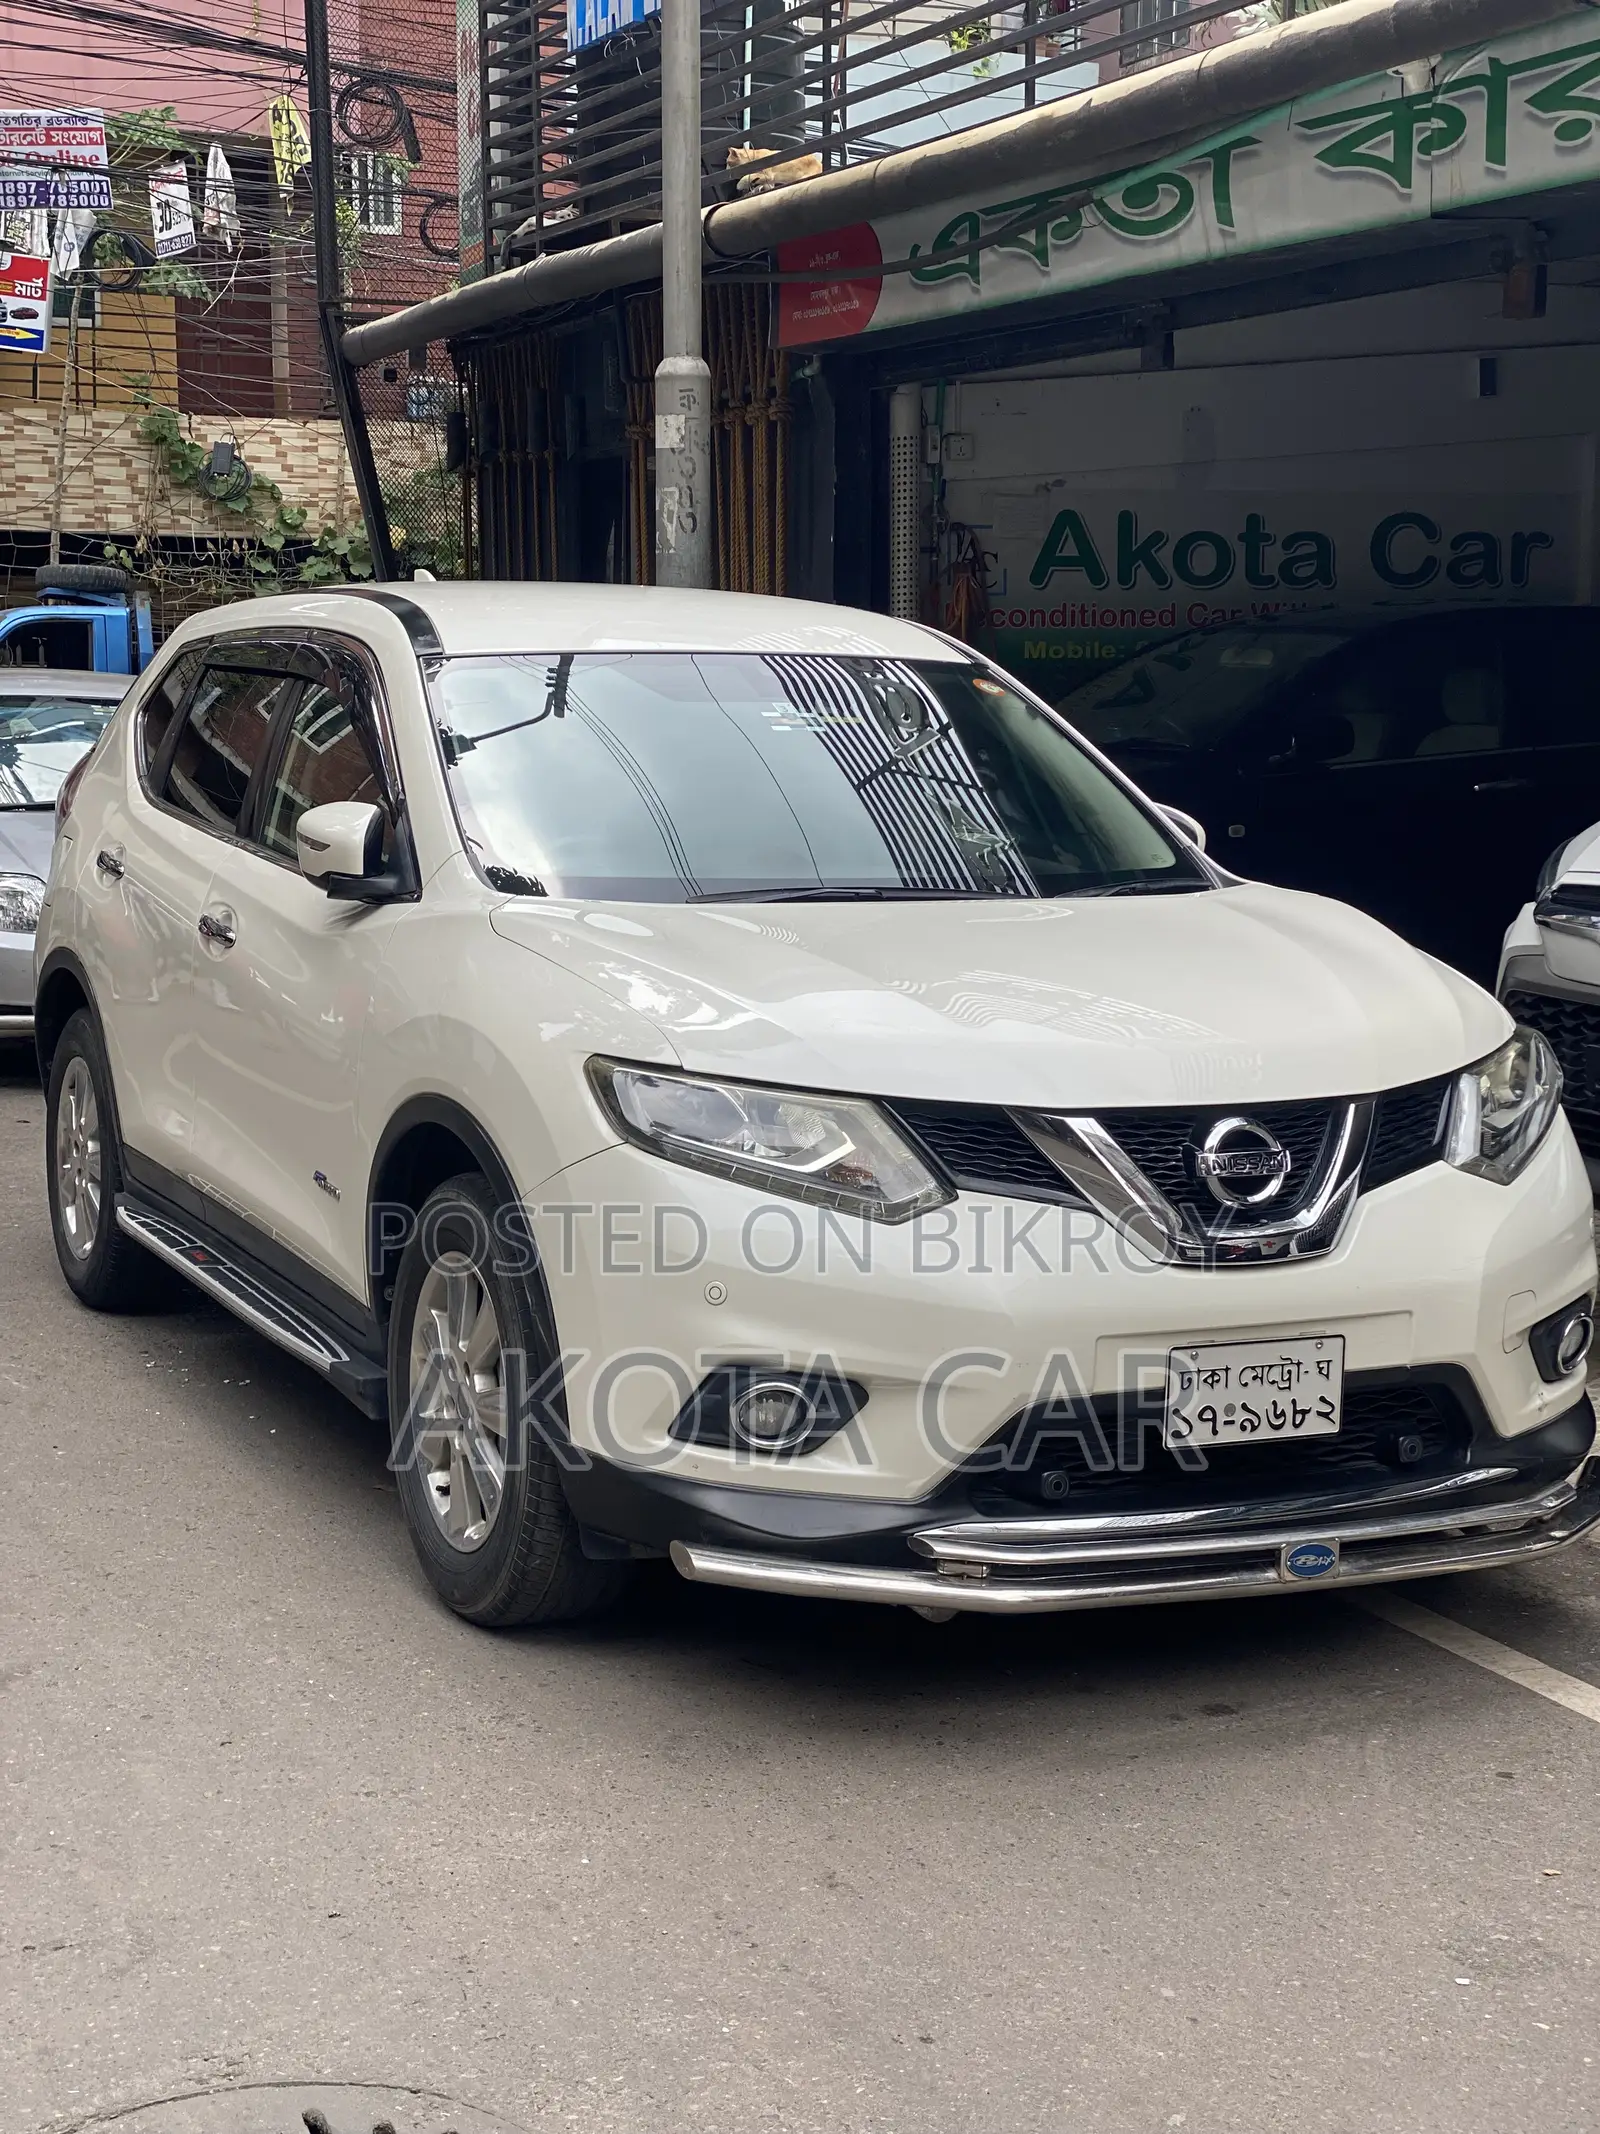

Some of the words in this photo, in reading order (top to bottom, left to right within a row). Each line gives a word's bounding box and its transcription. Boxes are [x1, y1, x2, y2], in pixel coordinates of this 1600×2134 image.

[49, 130, 102, 145] সংযোগ
[911, 135, 1263, 288] একতা
[1293, 38, 1600, 194] কার
[13, 277, 45, 298] মার্ট
[1028, 508, 1337, 591] Akota
[1369, 510, 1554, 591] Car
[945, 601, 1177, 629] conditioned
[1187, 601, 1243, 629] Car
[1024, 640, 1125, 660] Mobile:
[1211, 1153, 1284, 1172] NISSAN
[1179, 1365, 1232, 1391] ঢাকা
[1170, 1395, 1337, 1439] ১৭-৯৬৮২
